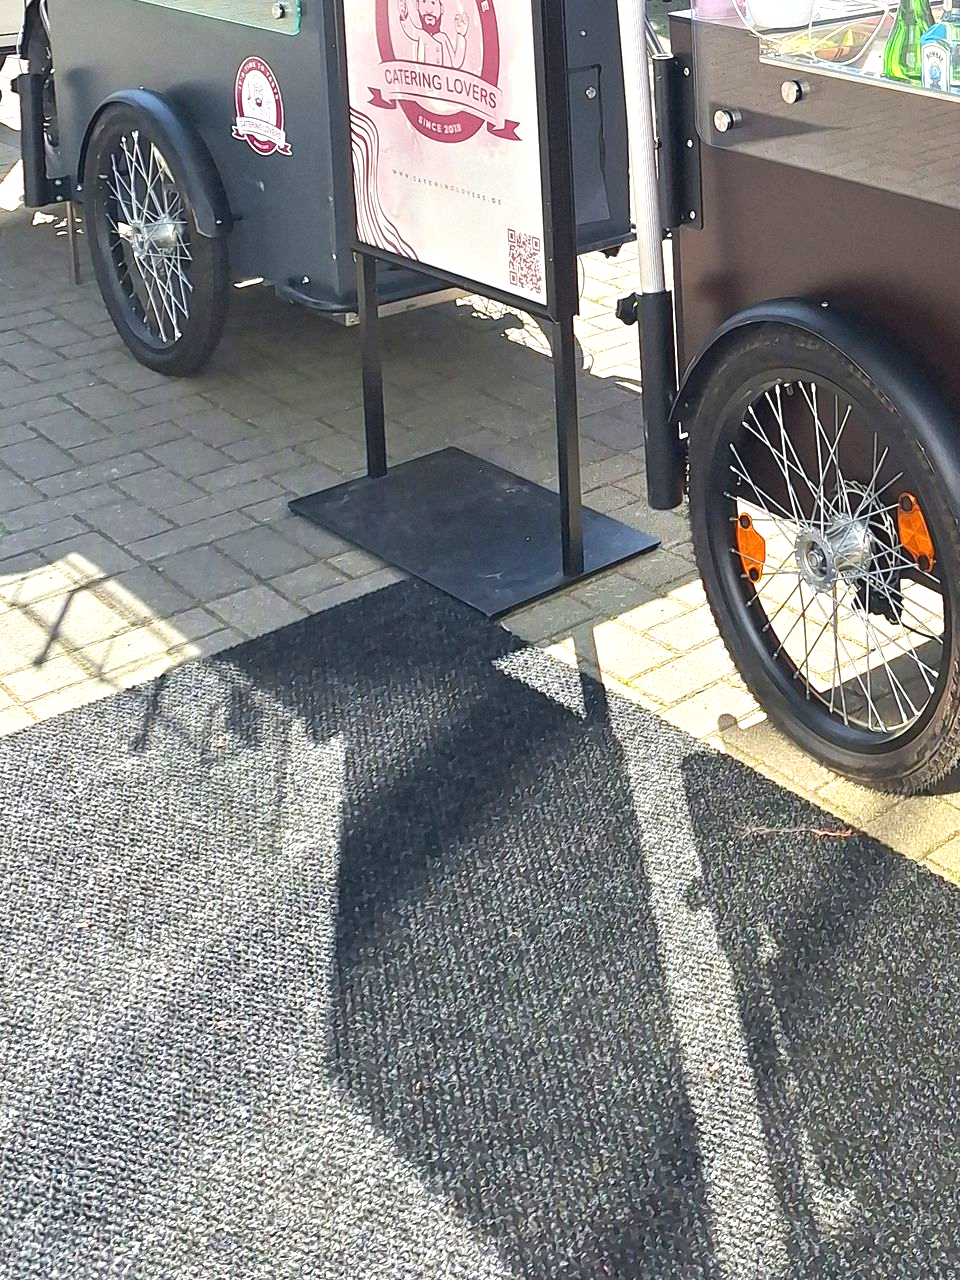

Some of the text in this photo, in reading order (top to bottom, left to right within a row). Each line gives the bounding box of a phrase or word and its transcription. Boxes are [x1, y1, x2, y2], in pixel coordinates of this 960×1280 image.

[384, 69, 497, 109] CATERING LOVERS
[417, 115, 442, 134] SINCE
